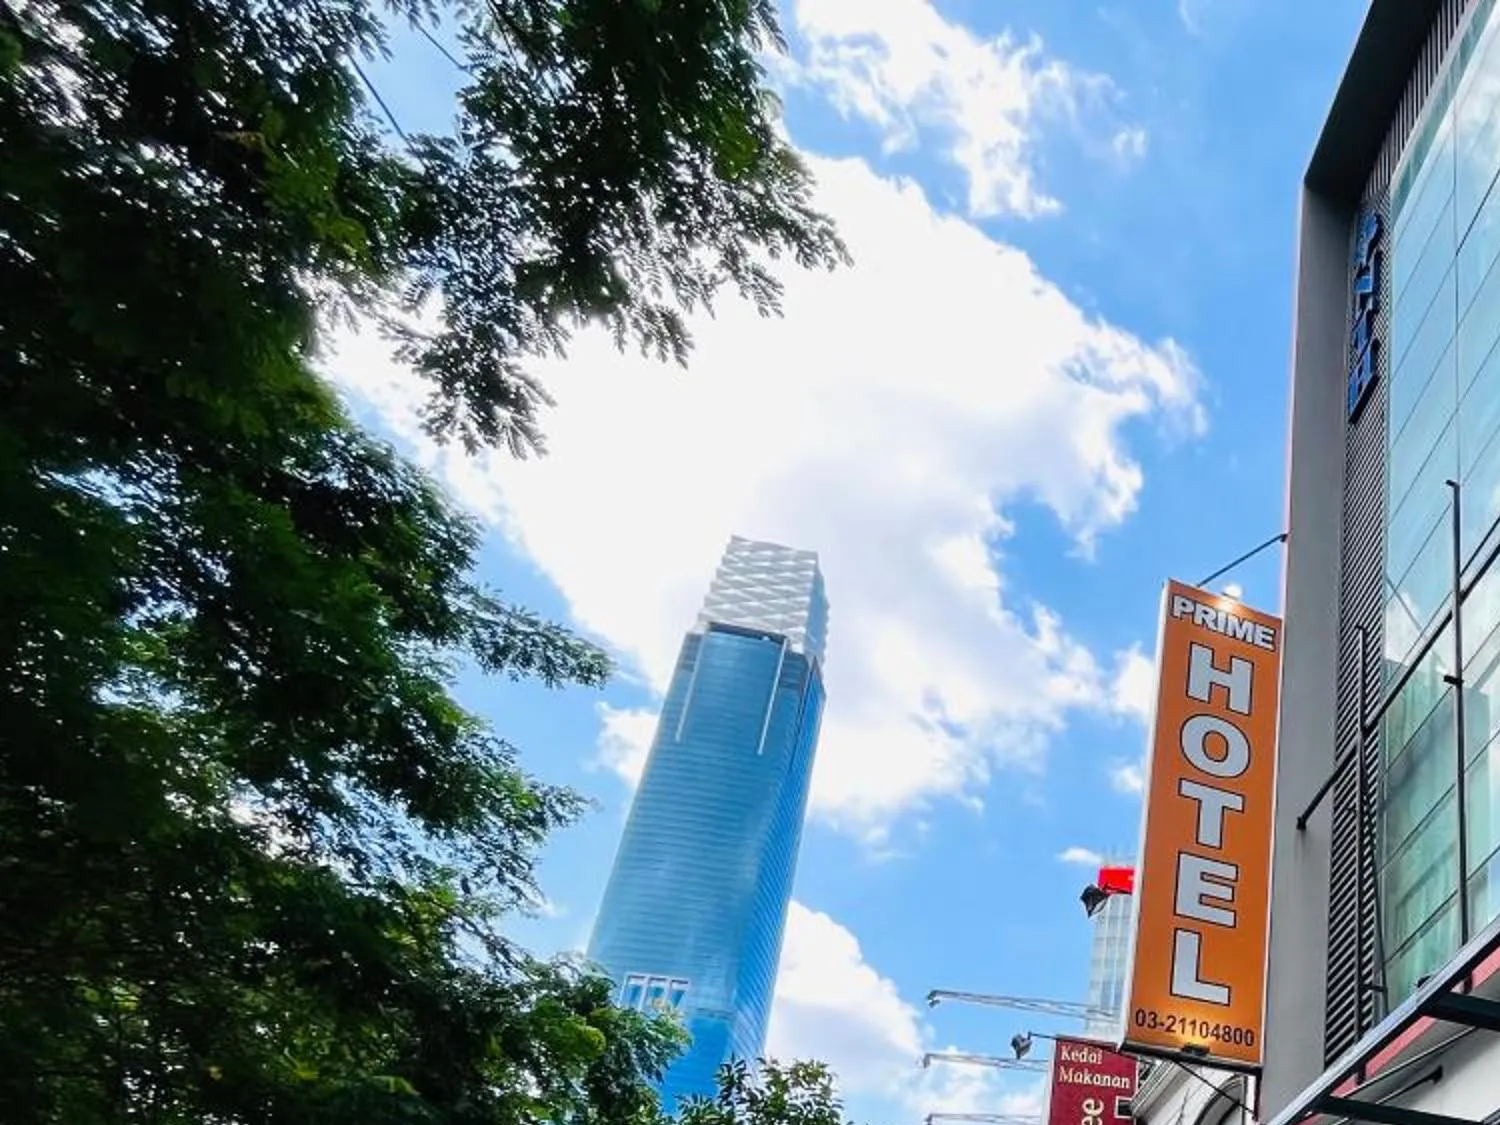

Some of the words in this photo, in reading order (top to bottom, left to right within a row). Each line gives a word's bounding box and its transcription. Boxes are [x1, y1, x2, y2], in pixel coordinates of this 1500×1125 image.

[1172, 594, 1277, 652] PRIME
[1170, 641, 1255, 1007] HOTEL
[1135, 1008, 1255, 1047] 03-21104800
[1061, 1044, 1103, 1065] Kedai
[1059, 1065, 1130, 1089] Makanan
